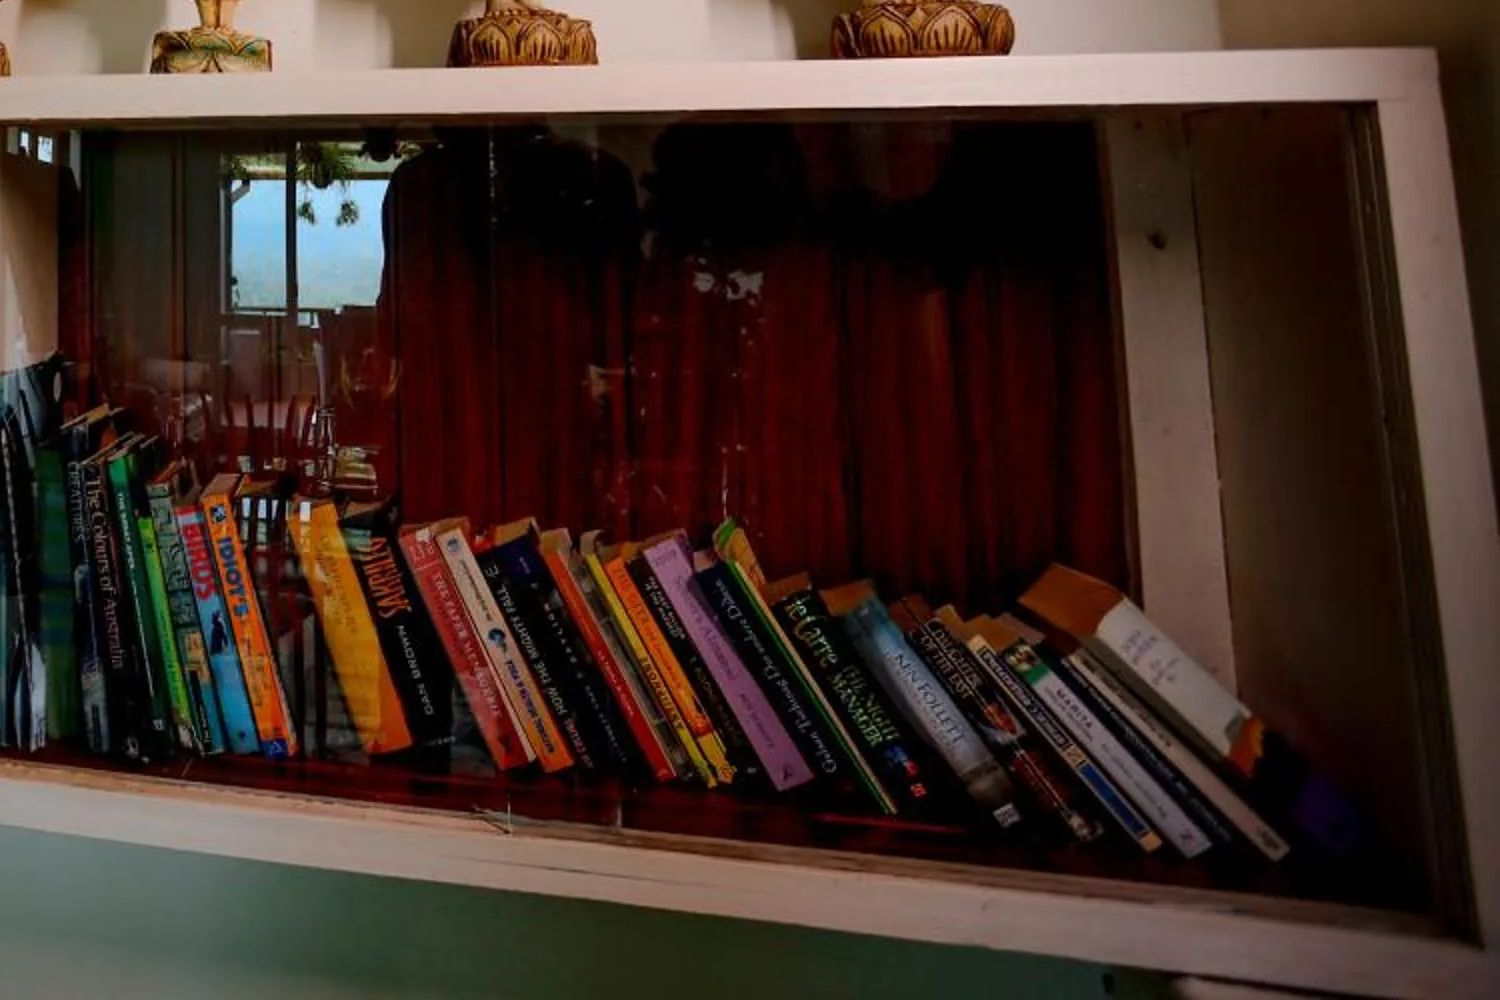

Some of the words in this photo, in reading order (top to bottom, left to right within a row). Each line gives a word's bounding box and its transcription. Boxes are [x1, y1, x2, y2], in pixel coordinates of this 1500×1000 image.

[84, 475, 105, 509] The
[89, 509, 113, 574] Colours
[98, 574, 116, 596] of
[101, 596, 128, 670] Australia
[394, 623, 422, 680] BROWN
[414, 681, 435, 717] DAN
[531, 659, 552, 686] THE
[543, 684, 568, 717] HOW
[826, 669, 886, 748] MANAGER
[839, 661, 869, 696] THE
[859, 690, 903, 745] NIGHT
[914, 680, 968, 745] FOLLETT
